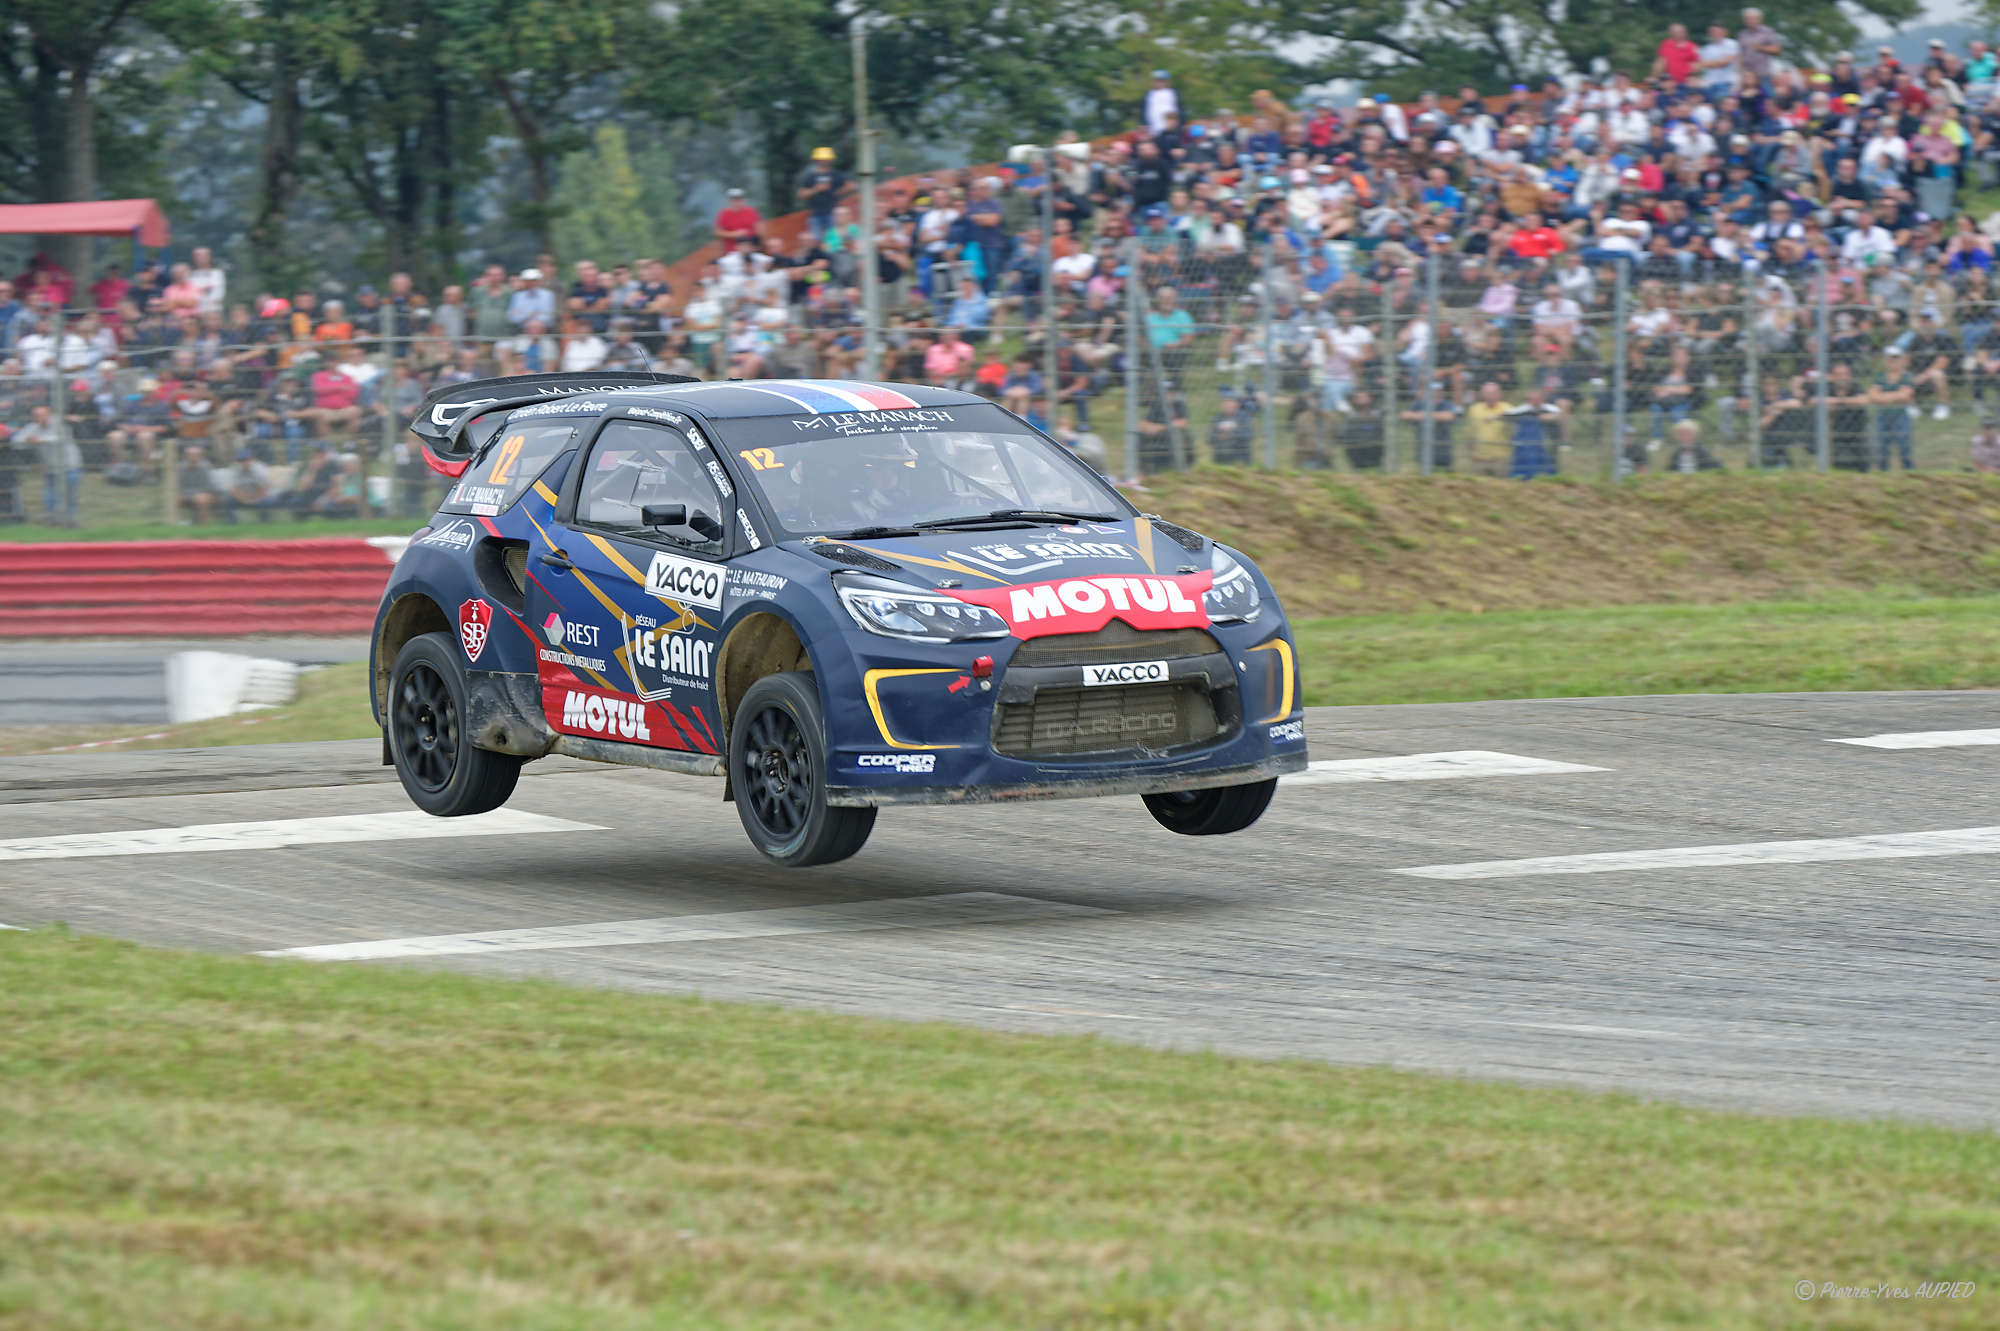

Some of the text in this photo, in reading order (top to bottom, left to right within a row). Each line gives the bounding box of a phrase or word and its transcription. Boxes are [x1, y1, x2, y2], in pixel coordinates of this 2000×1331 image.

[828, 413, 859, 427] LE
[487, 435, 525, 485] 12
[739, 447, 784, 471] 12
[976, 544, 1028, 562] LE
[1024, 542, 1133, 559] SAINT
[655, 562, 718, 600] YACCO
[732, 569, 788, 591] LE MATHURIN
[1009, 577, 1197, 623] MOTUL
[462, 622, 486, 641] SB
[635, 614, 657, 628] RÉSEAU
[566, 621, 600, 648] REST
[635, 628, 656, 668] LE
[1093, 664, 1160, 683] YACCO
[562, 690, 650, 741] MOTUL
[857, 754, 937, 767] COOPER
[895, 764, 934, 773] TIRES
